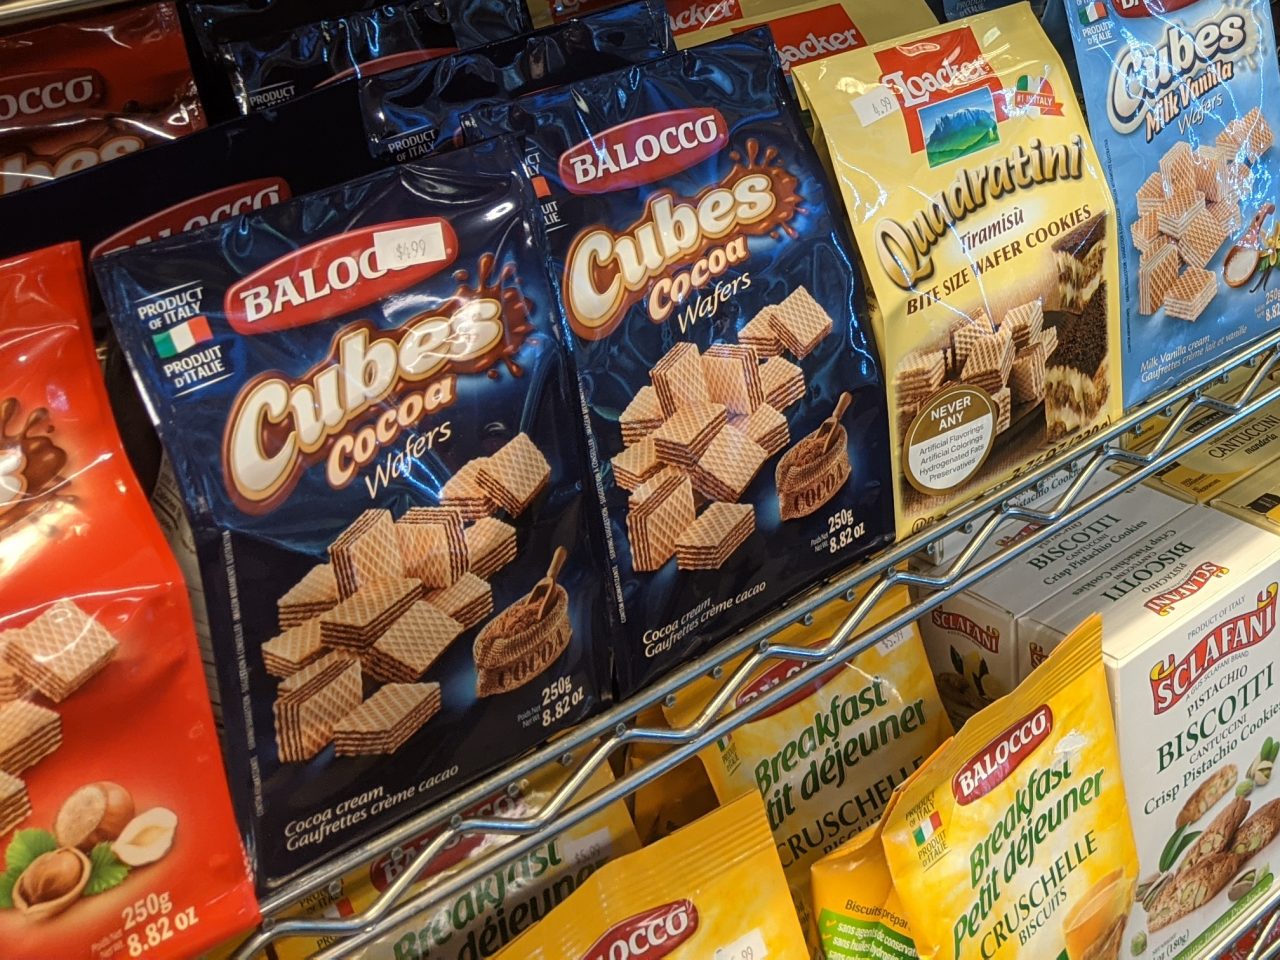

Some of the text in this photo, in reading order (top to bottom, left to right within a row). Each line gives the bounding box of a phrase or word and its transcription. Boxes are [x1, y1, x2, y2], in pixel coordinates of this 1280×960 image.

[883, 53, 990, 106] Loacker
[1110, 15, 1247, 128] Cubes
[1145, 59, 1235, 143] Milk Vanilla
[872, 96, 892, 116] 4.99
[388, 130, 435, 153] PRODUCT
[570, 116, 717, 184] BALOCCO
[874, 136, 1083, 290] Quadratini
[960, 207, 1025, 253] Tiramisù
[570, 174, 776, 328] Cubes
[906, 205, 1092, 315] BITE SIZE WAFER COOKIES
[138, 287, 204, 319] PRODUCT
[240, 244, 420, 323] BALOC
[677, 272, 751, 334] Wafers
[163, 345, 222, 377] PRODUIT
[1140, 335, 1211, 373] Milk Vanilla cream
[232, 297, 502, 504] Cubes
[931, 396, 972, 421] NEVER
[938, 414, 965, 432] ANY
[364, 422, 451, 500] Wafers
[919, 423, 984, 456] Artificial Flavorings
[920, 434, 984, 466] Artificial Colorings
[929, 458, 976, 483] Preservatives
[828, 508, 854, 534] 250g
[1026, 513, 1121, 571] BISCOTTI
[643, 597, 711, 645] Cocoa cream
[645, 581, 767, 658] Gaufrettes crème cacao
[1155, 603, 1278, 715] SCLAFANI
[541, 675, 572, 705] 250g
[1156, 662, 1275, 775] BISCOTTI
[1187, 665, 1249, 718] PISTACHIO
[755, 676, 888, 796] Breakfast
[801, 697, 928, 803] déjeuner
[958, 710, 1046, 797] BALOCCO
[1189, 713, 1248, 765] CANTUCCINI
[1144, 784, 1180, 815] Crisp
[1183, 738, 1238, 788] Pistachio
[284, 785, 384, 839] Cocoa cream
[286, 765, 459, 852] Gaufrettes crème cacao
[970, 758, 1072, 888] Breakfast
[953, 769, 1105, 948] Petit déjeuner
[121, 891, 173, 928] 250g
[980, 830, 1098, 960] CRUSCHELLE
[1019, 886, 1068, 947] BISCUITS
[127, 907, 199, 958] 8.82 oz
